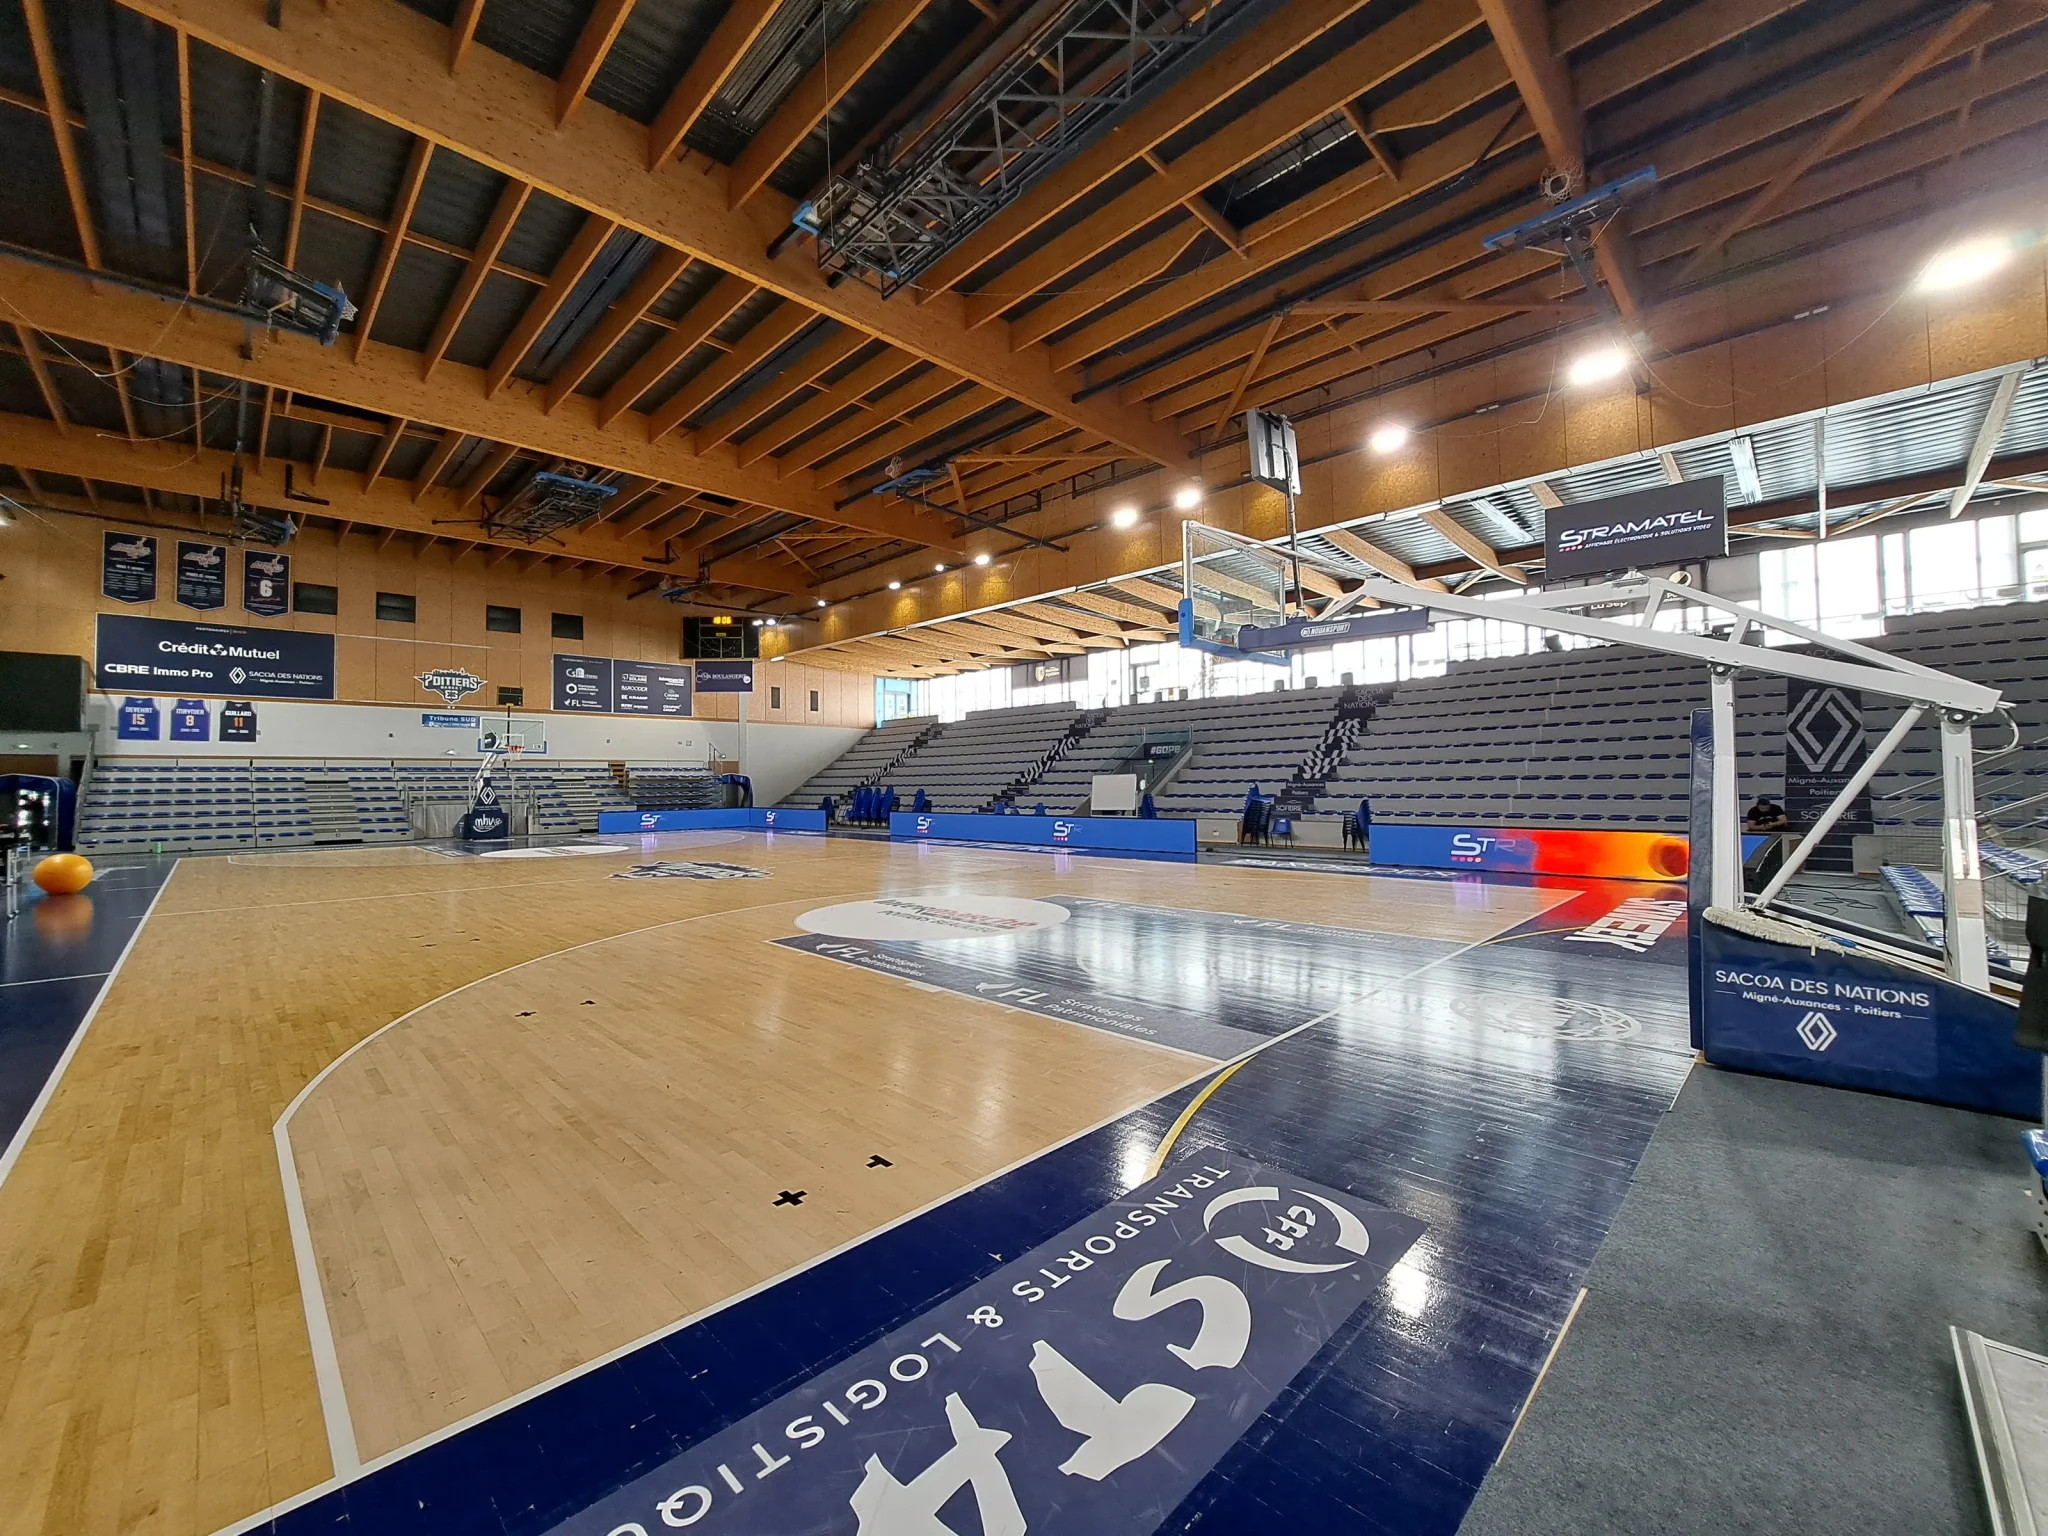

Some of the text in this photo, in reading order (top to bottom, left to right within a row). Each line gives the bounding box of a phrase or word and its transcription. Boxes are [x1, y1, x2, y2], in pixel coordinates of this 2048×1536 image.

[1558, 509, 1715, 549] STRAMATEL
[1660, 526, 1692, 537] SOLUTIONS
[259, 579, 273, 598] 6
[158, 640, 280, 660] Crédit Mutuel
[104, 663, 214, 679] CBRE Immo Pro
[424, 674, 478, 689] POITIERS
[1355, 687, 1384, 697] SACOA
[571, 699, 581, 707] FL
[1343, 700, 1379, 710] NATIONS
[132, 713, 146, 725] 15
[185, 715, 195, 727] 8
[234, 717, 244, 727] 11
[1450, 833, 1516, 857] STR
[826, 946, 870, 959] FL
[995, 987, 1051, 1006] FL
[1715, 969, 1931, 1008] SACOA DES NATIONS
[1060, 998, 1145, 1023] Stratégies
[1742, 990, 1842, 1012] Migné-Auxances
[1853, 1004, 1903, 1019] Poitiers
[1042, 1003, 1159, 1036] Patrimoniales
[1012, 1164, 1231, 1303] TRANSPORTS
[967, 1304, 1004, 1329] &
